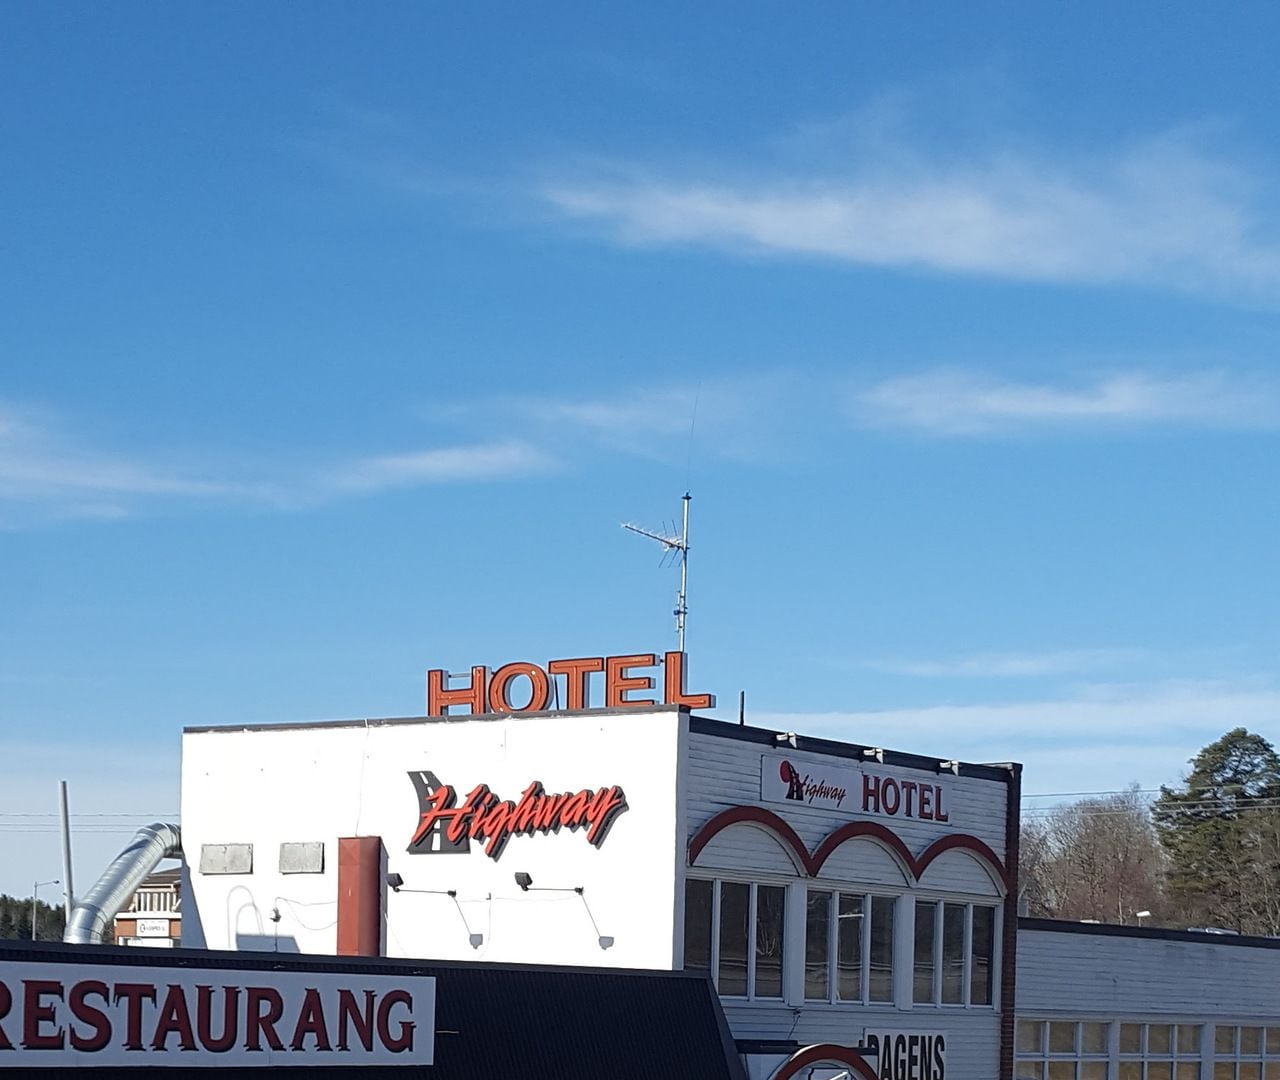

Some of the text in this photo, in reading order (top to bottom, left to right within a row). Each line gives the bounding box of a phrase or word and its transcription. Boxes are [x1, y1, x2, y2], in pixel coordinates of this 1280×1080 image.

[427, 651, 716, 717] HOTEL
[411, 781, 628, 862] Highway
[787, 773, 949, 822] Highway HOTEL
